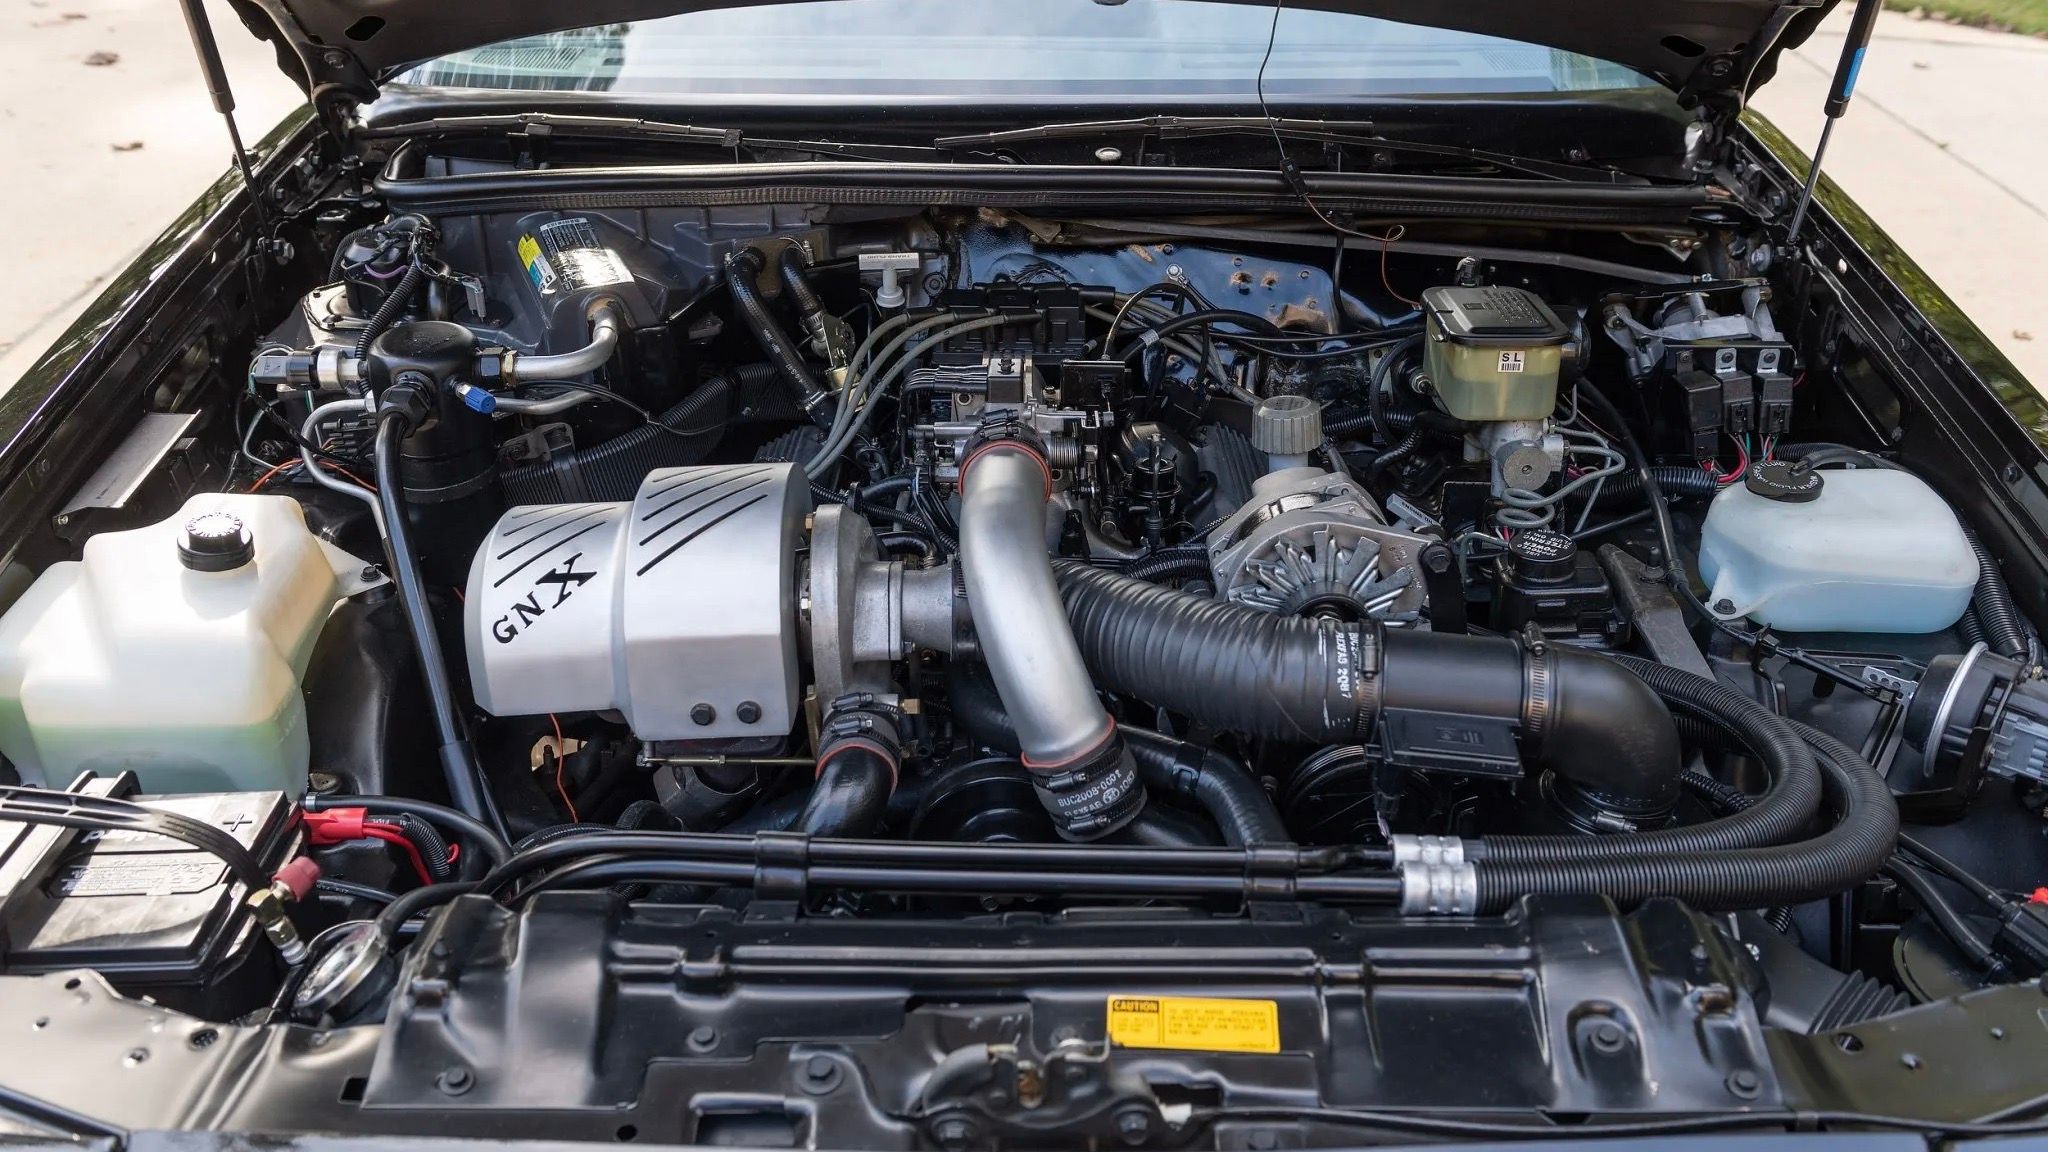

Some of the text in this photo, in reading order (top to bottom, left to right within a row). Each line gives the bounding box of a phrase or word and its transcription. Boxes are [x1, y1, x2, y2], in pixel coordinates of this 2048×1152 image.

[1523, 534, 1570, 549] STEERING
[1523, 541, 1558, 553] POWER
[492, 552, 597, 644] GNX
[1114, 1000, 1159, 1012] CAUTION
